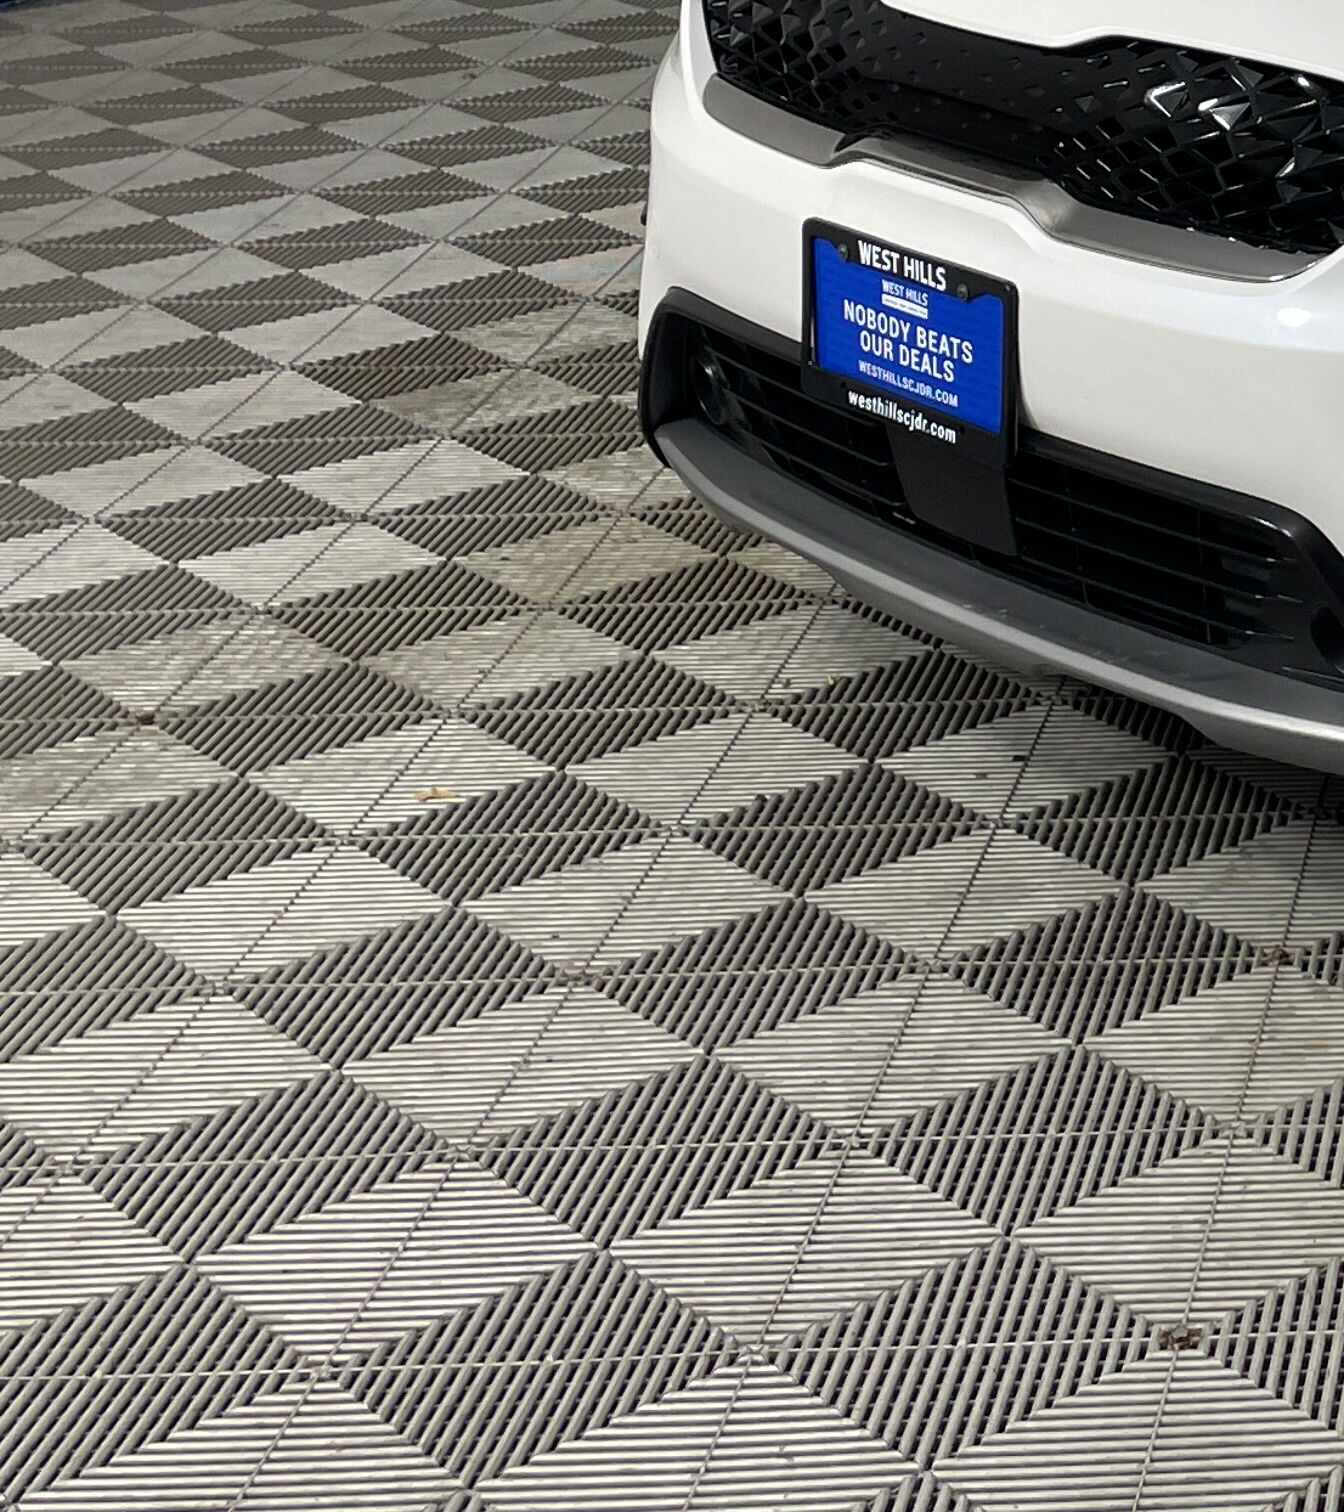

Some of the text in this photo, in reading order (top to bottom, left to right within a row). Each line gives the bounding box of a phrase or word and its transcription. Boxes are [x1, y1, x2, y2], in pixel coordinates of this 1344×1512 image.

[858, 239, 947, 292] WEST HILLS
[881, 279, 928, 306] WEST HILLS
[843, 299, 910, 342] NOBODY
[916, 326, 973, 364] BEATS
[860, 330, 955, 383] OUR DEALS
[858, 360, 959, 408] WESTHILLSCJDR.COM
[848, 391, 956, 444] westhillscjdr.com
